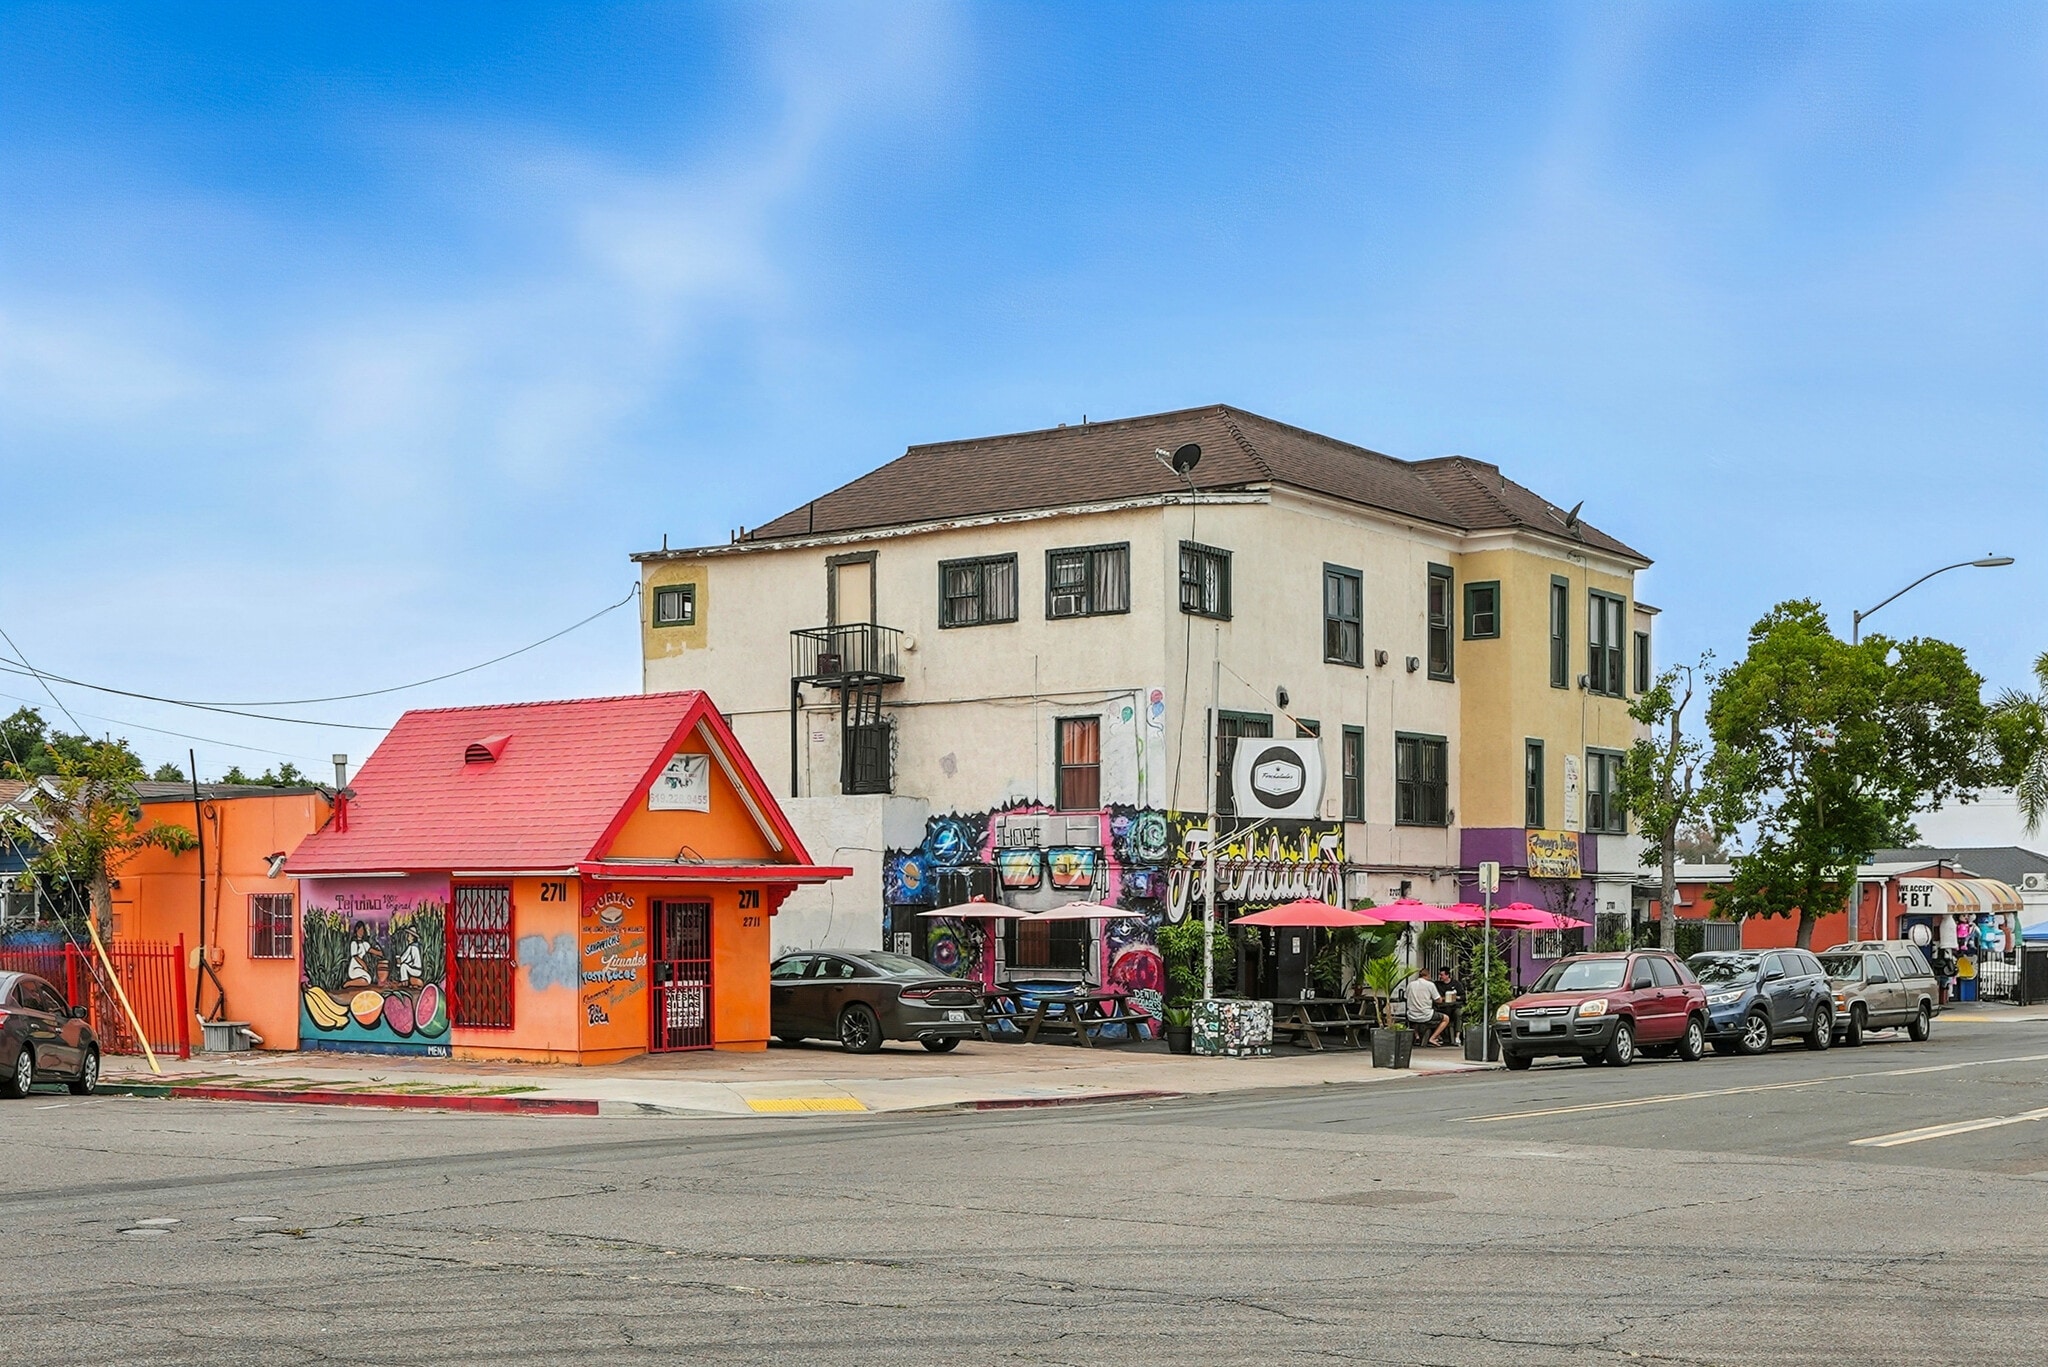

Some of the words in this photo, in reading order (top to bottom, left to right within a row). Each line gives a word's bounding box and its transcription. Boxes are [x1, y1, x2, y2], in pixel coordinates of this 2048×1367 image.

[1003, 826, 1042, 846] HOPE
[540, 883, 567, 902] 2711
[1910, 885, 1934, 893] ACCEPT
[335, 894, 382, 918] Tejuino
[738, 889, 760, 909] 2711
[743, 916, 760, 927] 2711
[601, 950, 648, 971] Licuados
[427, 1045, 447, 1057] MENA
